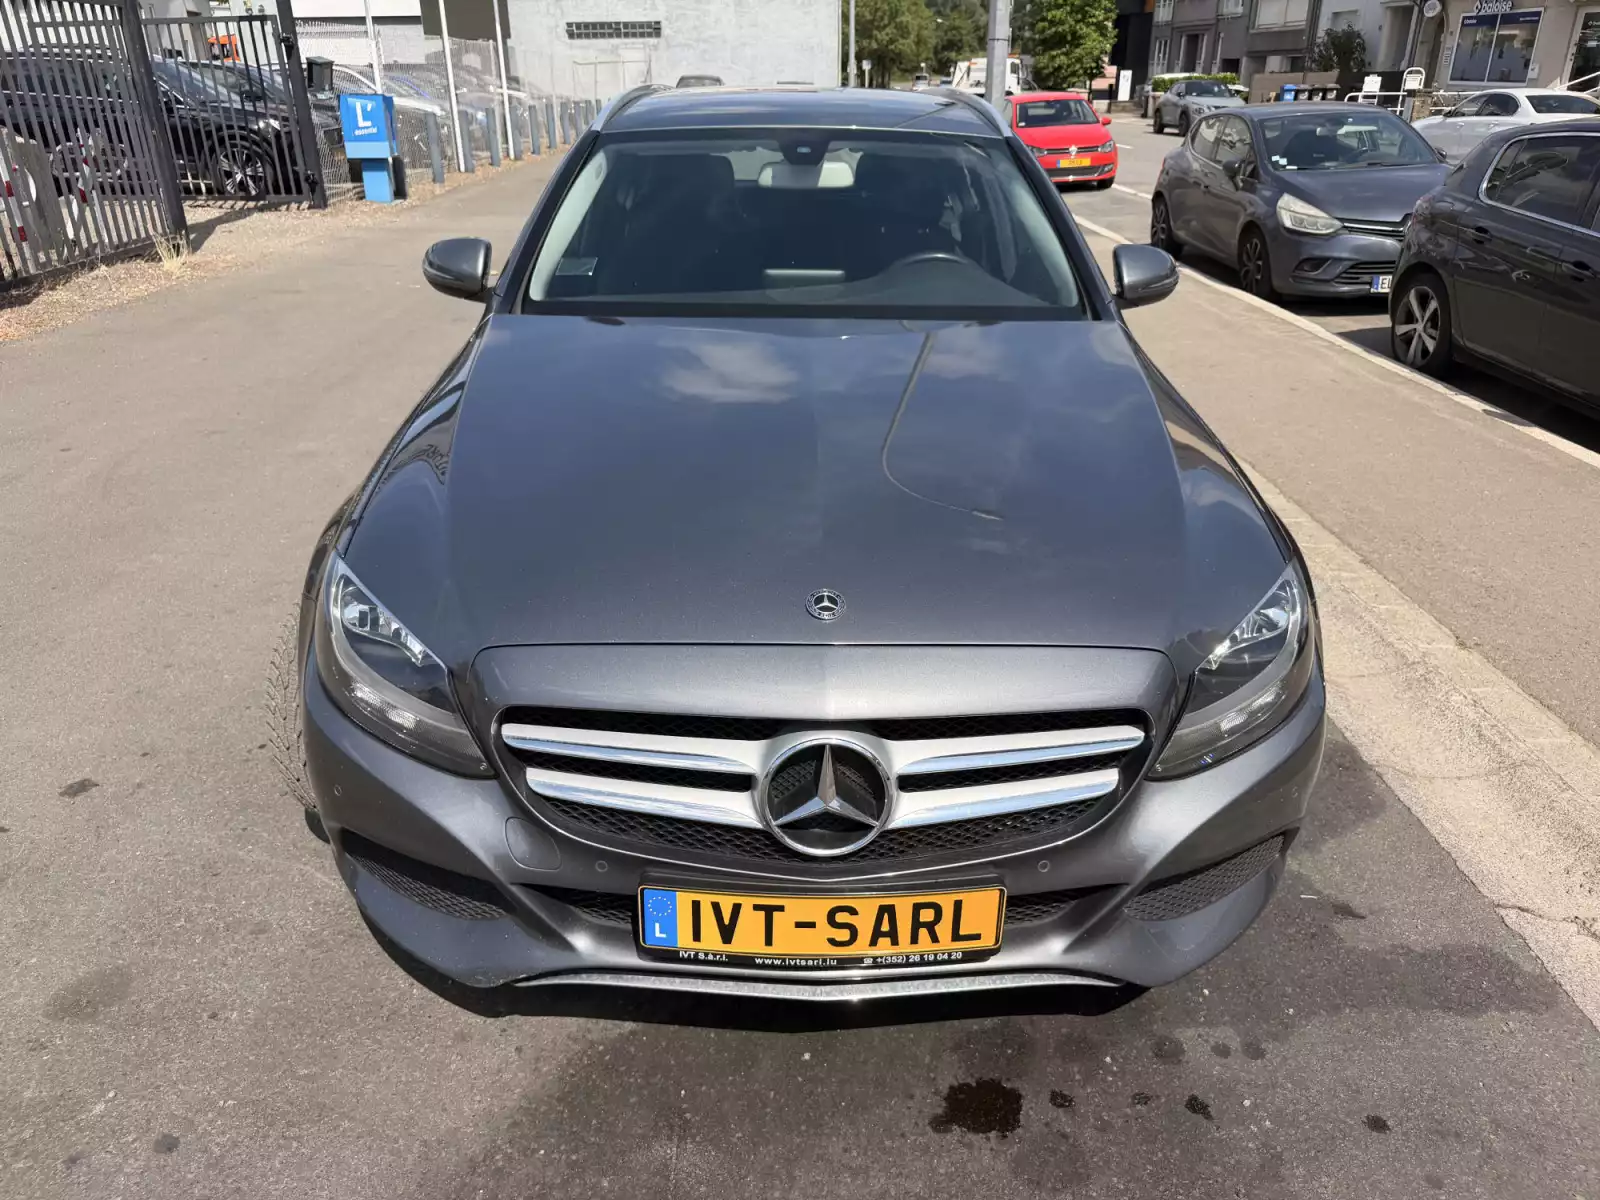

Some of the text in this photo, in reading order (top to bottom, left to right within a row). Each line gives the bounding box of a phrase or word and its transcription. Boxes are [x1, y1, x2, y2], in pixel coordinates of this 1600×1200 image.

[1482, 0, 1512, 13] baloise
[654, 922, 666, 937] L
[691, 899, 982, 947] IVT-SARL
[679, 950, 695, 960] IVT
[754, 957, 838, 966] www.ivtsarl.lu
[876, 952, 963, 965] +(352) 26 19 04 20
